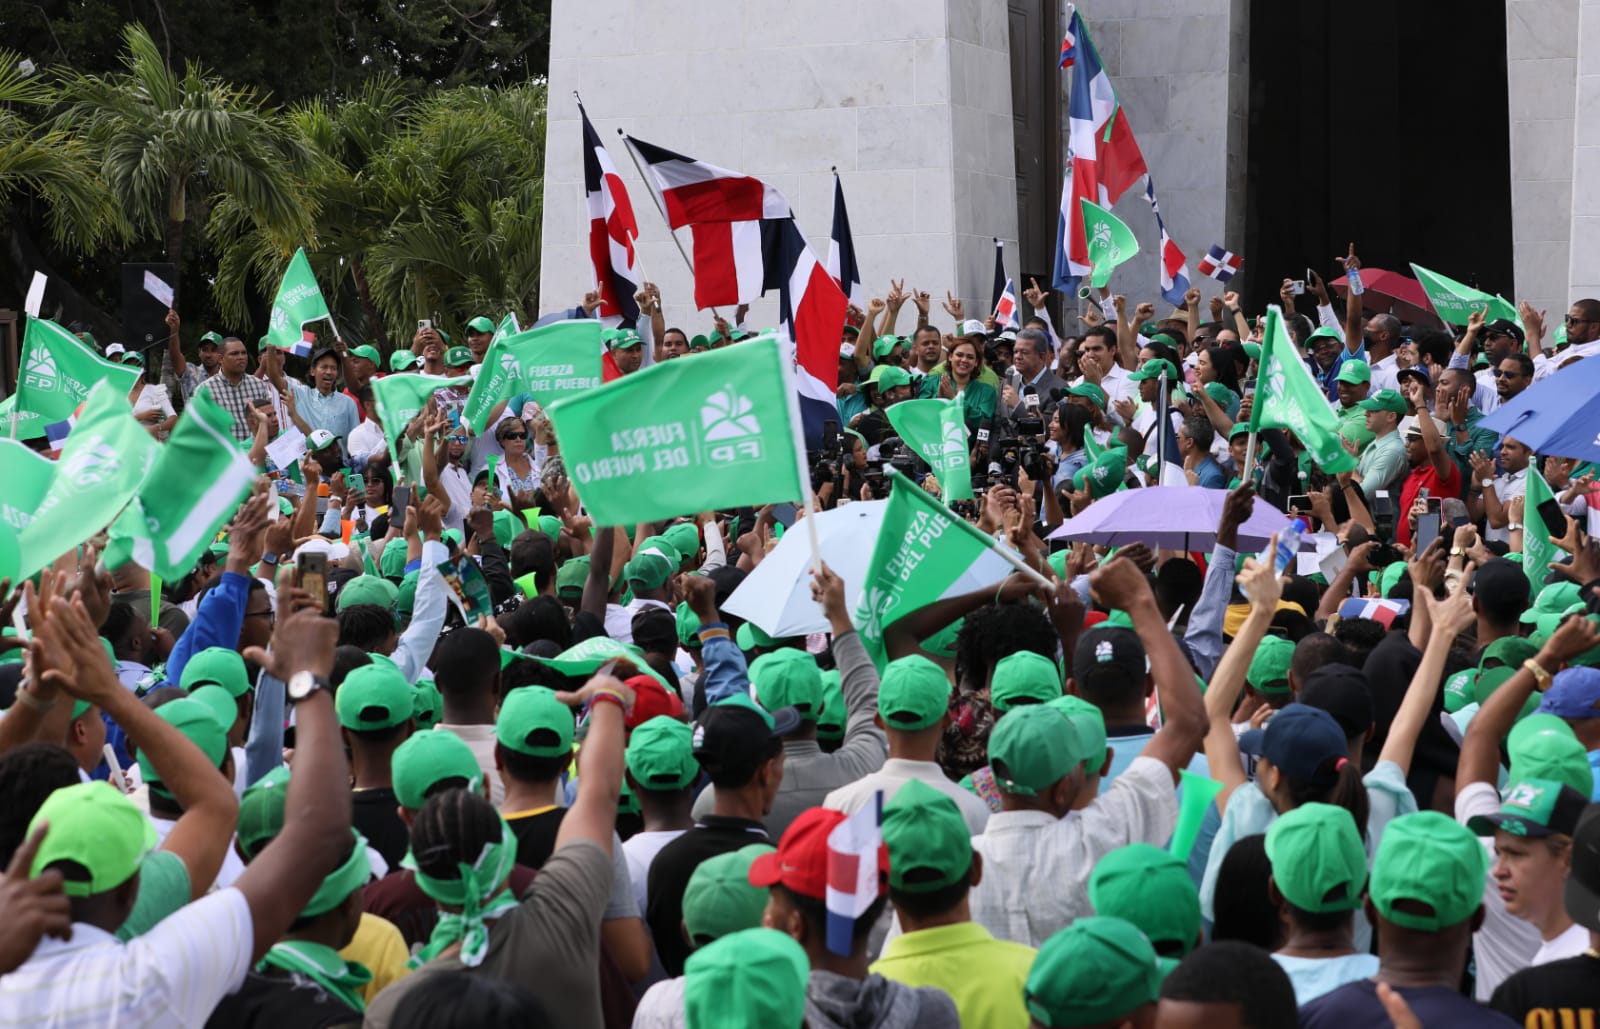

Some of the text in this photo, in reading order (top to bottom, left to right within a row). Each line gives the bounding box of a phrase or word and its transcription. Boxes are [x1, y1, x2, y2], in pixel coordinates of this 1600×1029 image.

[530, 364, 574, 379] FUERZA
[25, 374, 53, 389] FP
[531, 376, 601, 392] DEL PUEBLO
[885, 508, 930, 577] FUERZA
[900, 512, 953, 582] DEL PUE
